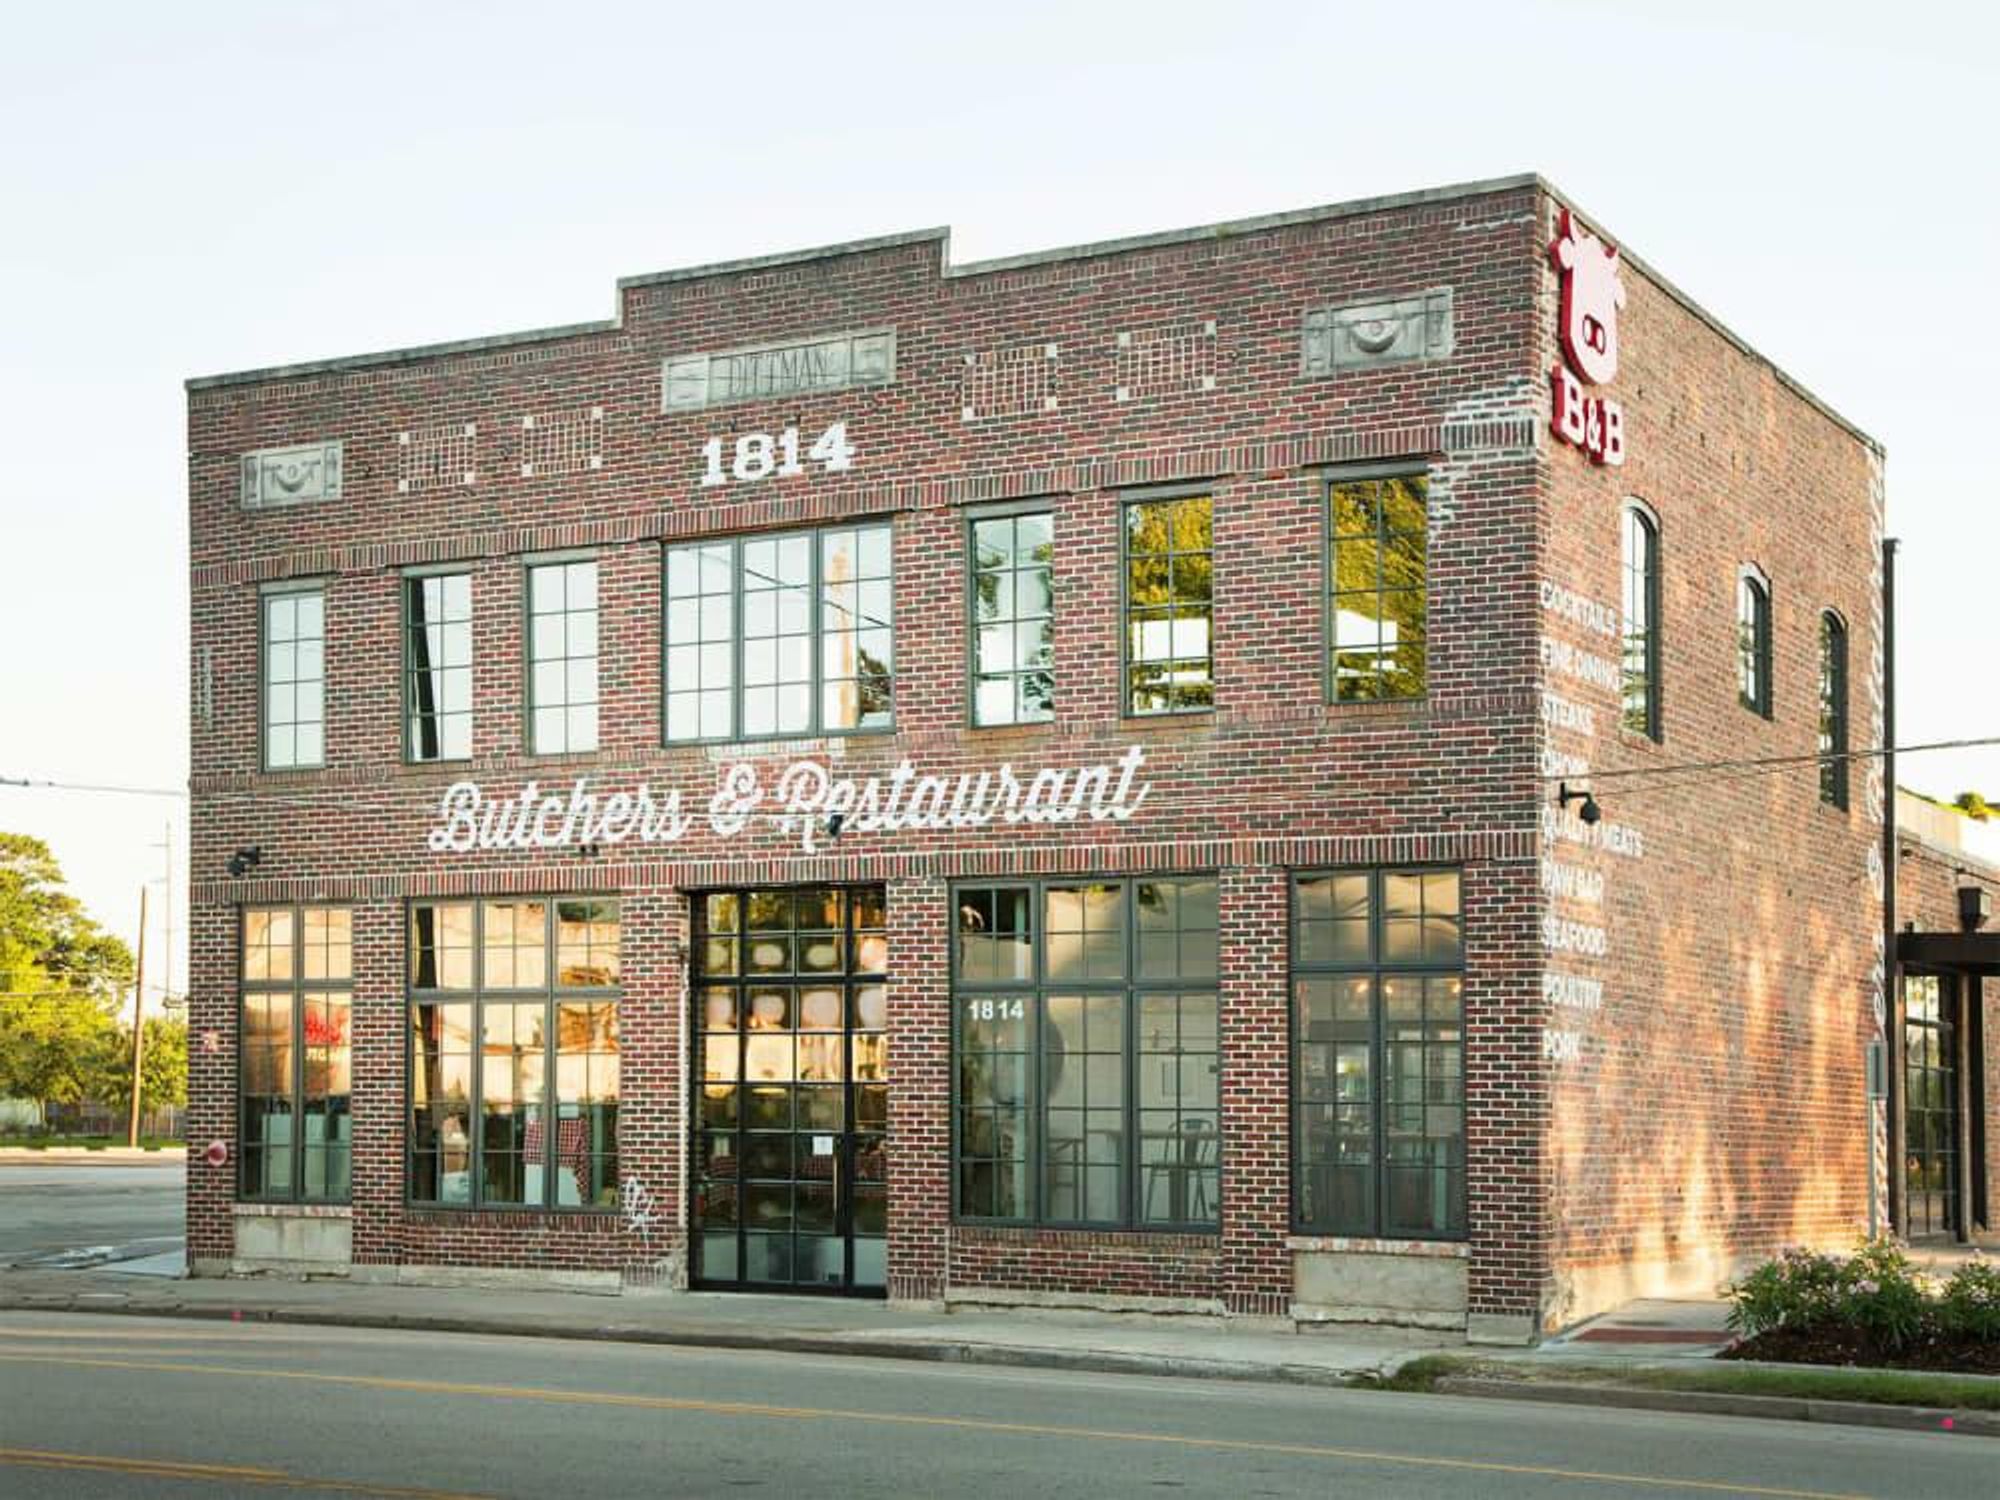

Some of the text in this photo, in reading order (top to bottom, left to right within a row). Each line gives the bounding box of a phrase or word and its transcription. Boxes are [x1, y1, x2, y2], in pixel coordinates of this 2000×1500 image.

[728, 347, 829, 397] DITTMAN
[1551, 362, 1625, 466] B&B
[702, 422, 855, 487] 1814
[1541, 691, 1593, 736] STEAKS
[428, 746, 1151, 854] Butchers & Restaurant
[1541, 916, 1606, 956] SEAFOOD
[968, 999, 1024, 1020] 1814
